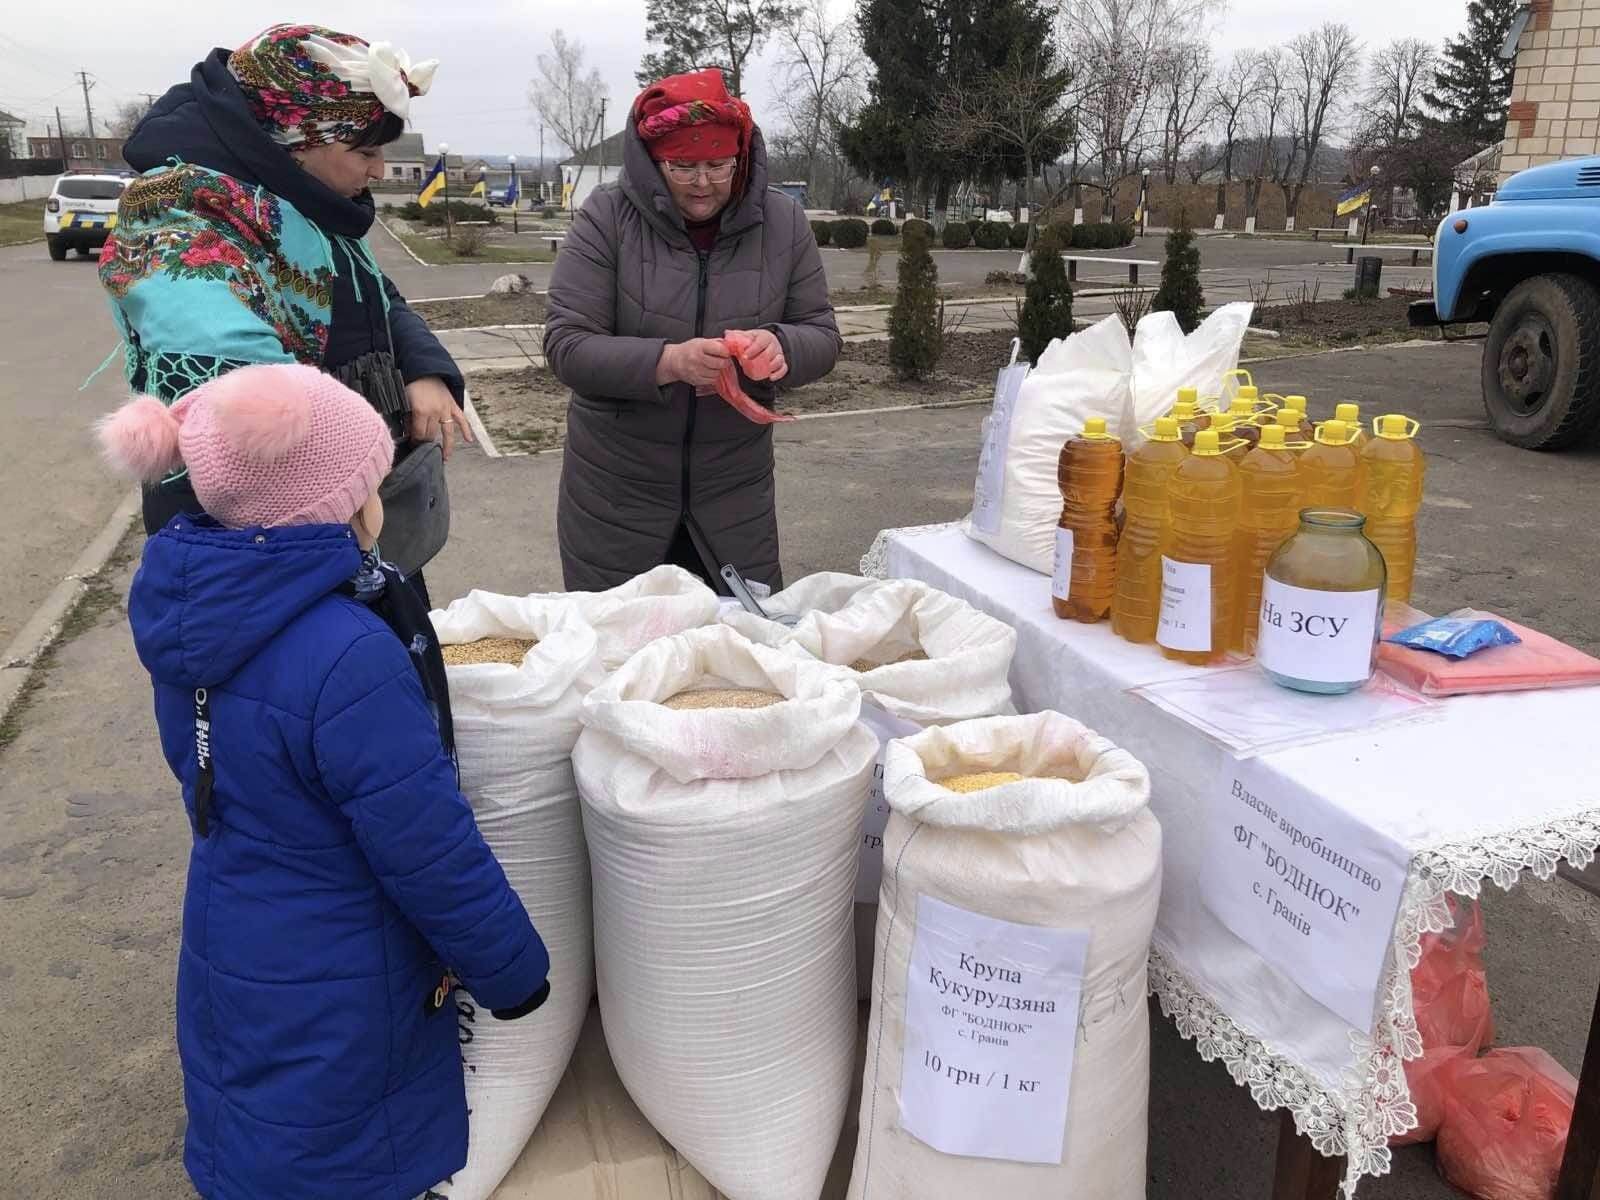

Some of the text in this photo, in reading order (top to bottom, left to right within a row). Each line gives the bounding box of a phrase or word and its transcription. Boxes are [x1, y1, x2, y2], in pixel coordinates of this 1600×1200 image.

[1263, 600, 1349, 638] На ЗСУ
[1231, 779, 1382, 892] Власне виробництво
[1234, 825, 1360, 921] ФГ "БОДНЮК"
[1253, 881, 1311, 936] с. Гранів
[959, 952, 1022, 984] Крупа
[929, 966, 1056, 1013] Кукурудзяна
[941, 1005, 1033, 1034] ФГ "БОДНЮК"
[971, 1030, 1009, 1047] Гранів
[924, 1050, 1041, 1092] 10 грн / 1 кг
